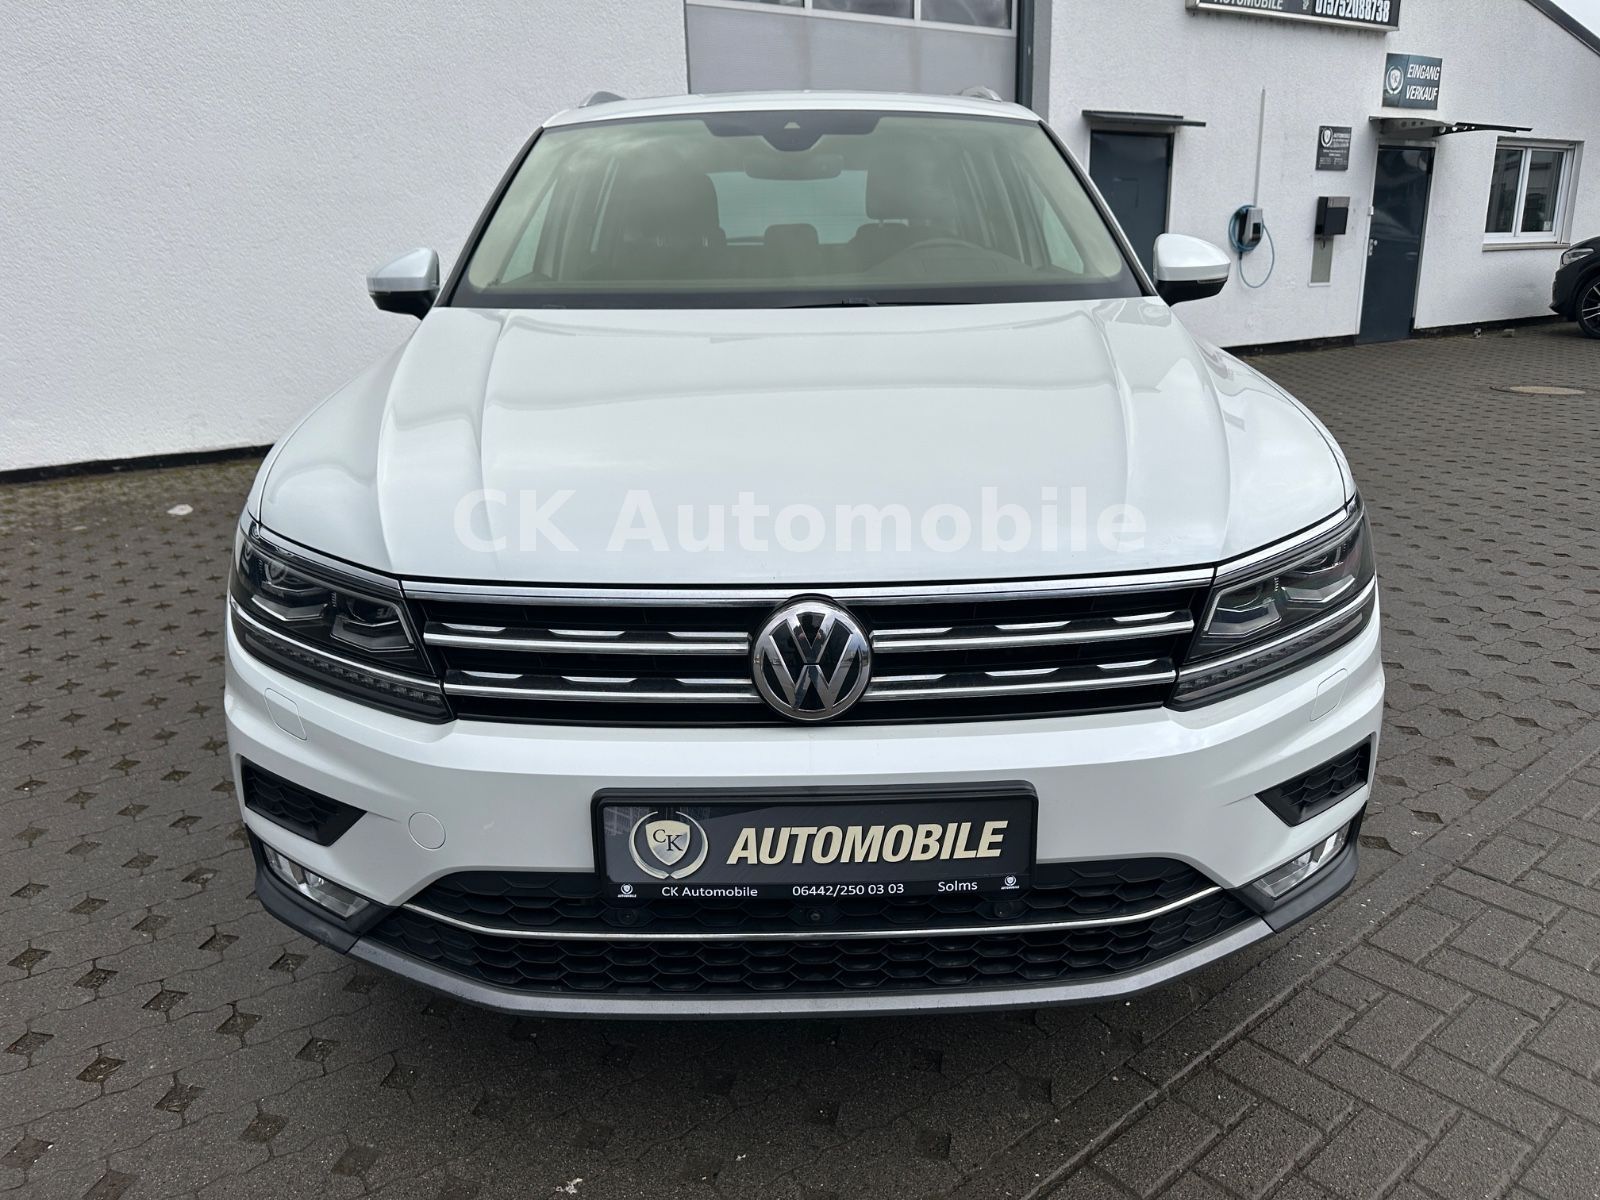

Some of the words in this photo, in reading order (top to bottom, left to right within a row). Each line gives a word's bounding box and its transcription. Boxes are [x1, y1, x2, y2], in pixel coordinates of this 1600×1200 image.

[1407, 64, 1440, 81] EINGANG
[1406, 85, 1438, 101] VERKAUF
[652, 828, 684, 852] CK
[726, 820, 1009, 865] AUTOMOBILE
[661, 886, 679, 897] CK
[682, 886, 758, 897] Automobile
[792, 884, 865, 898] 06442/250
[868, 884, 884, 895] 03
[888, 883, 905, 894] 03
[937, 880, 978, 892] Solms
